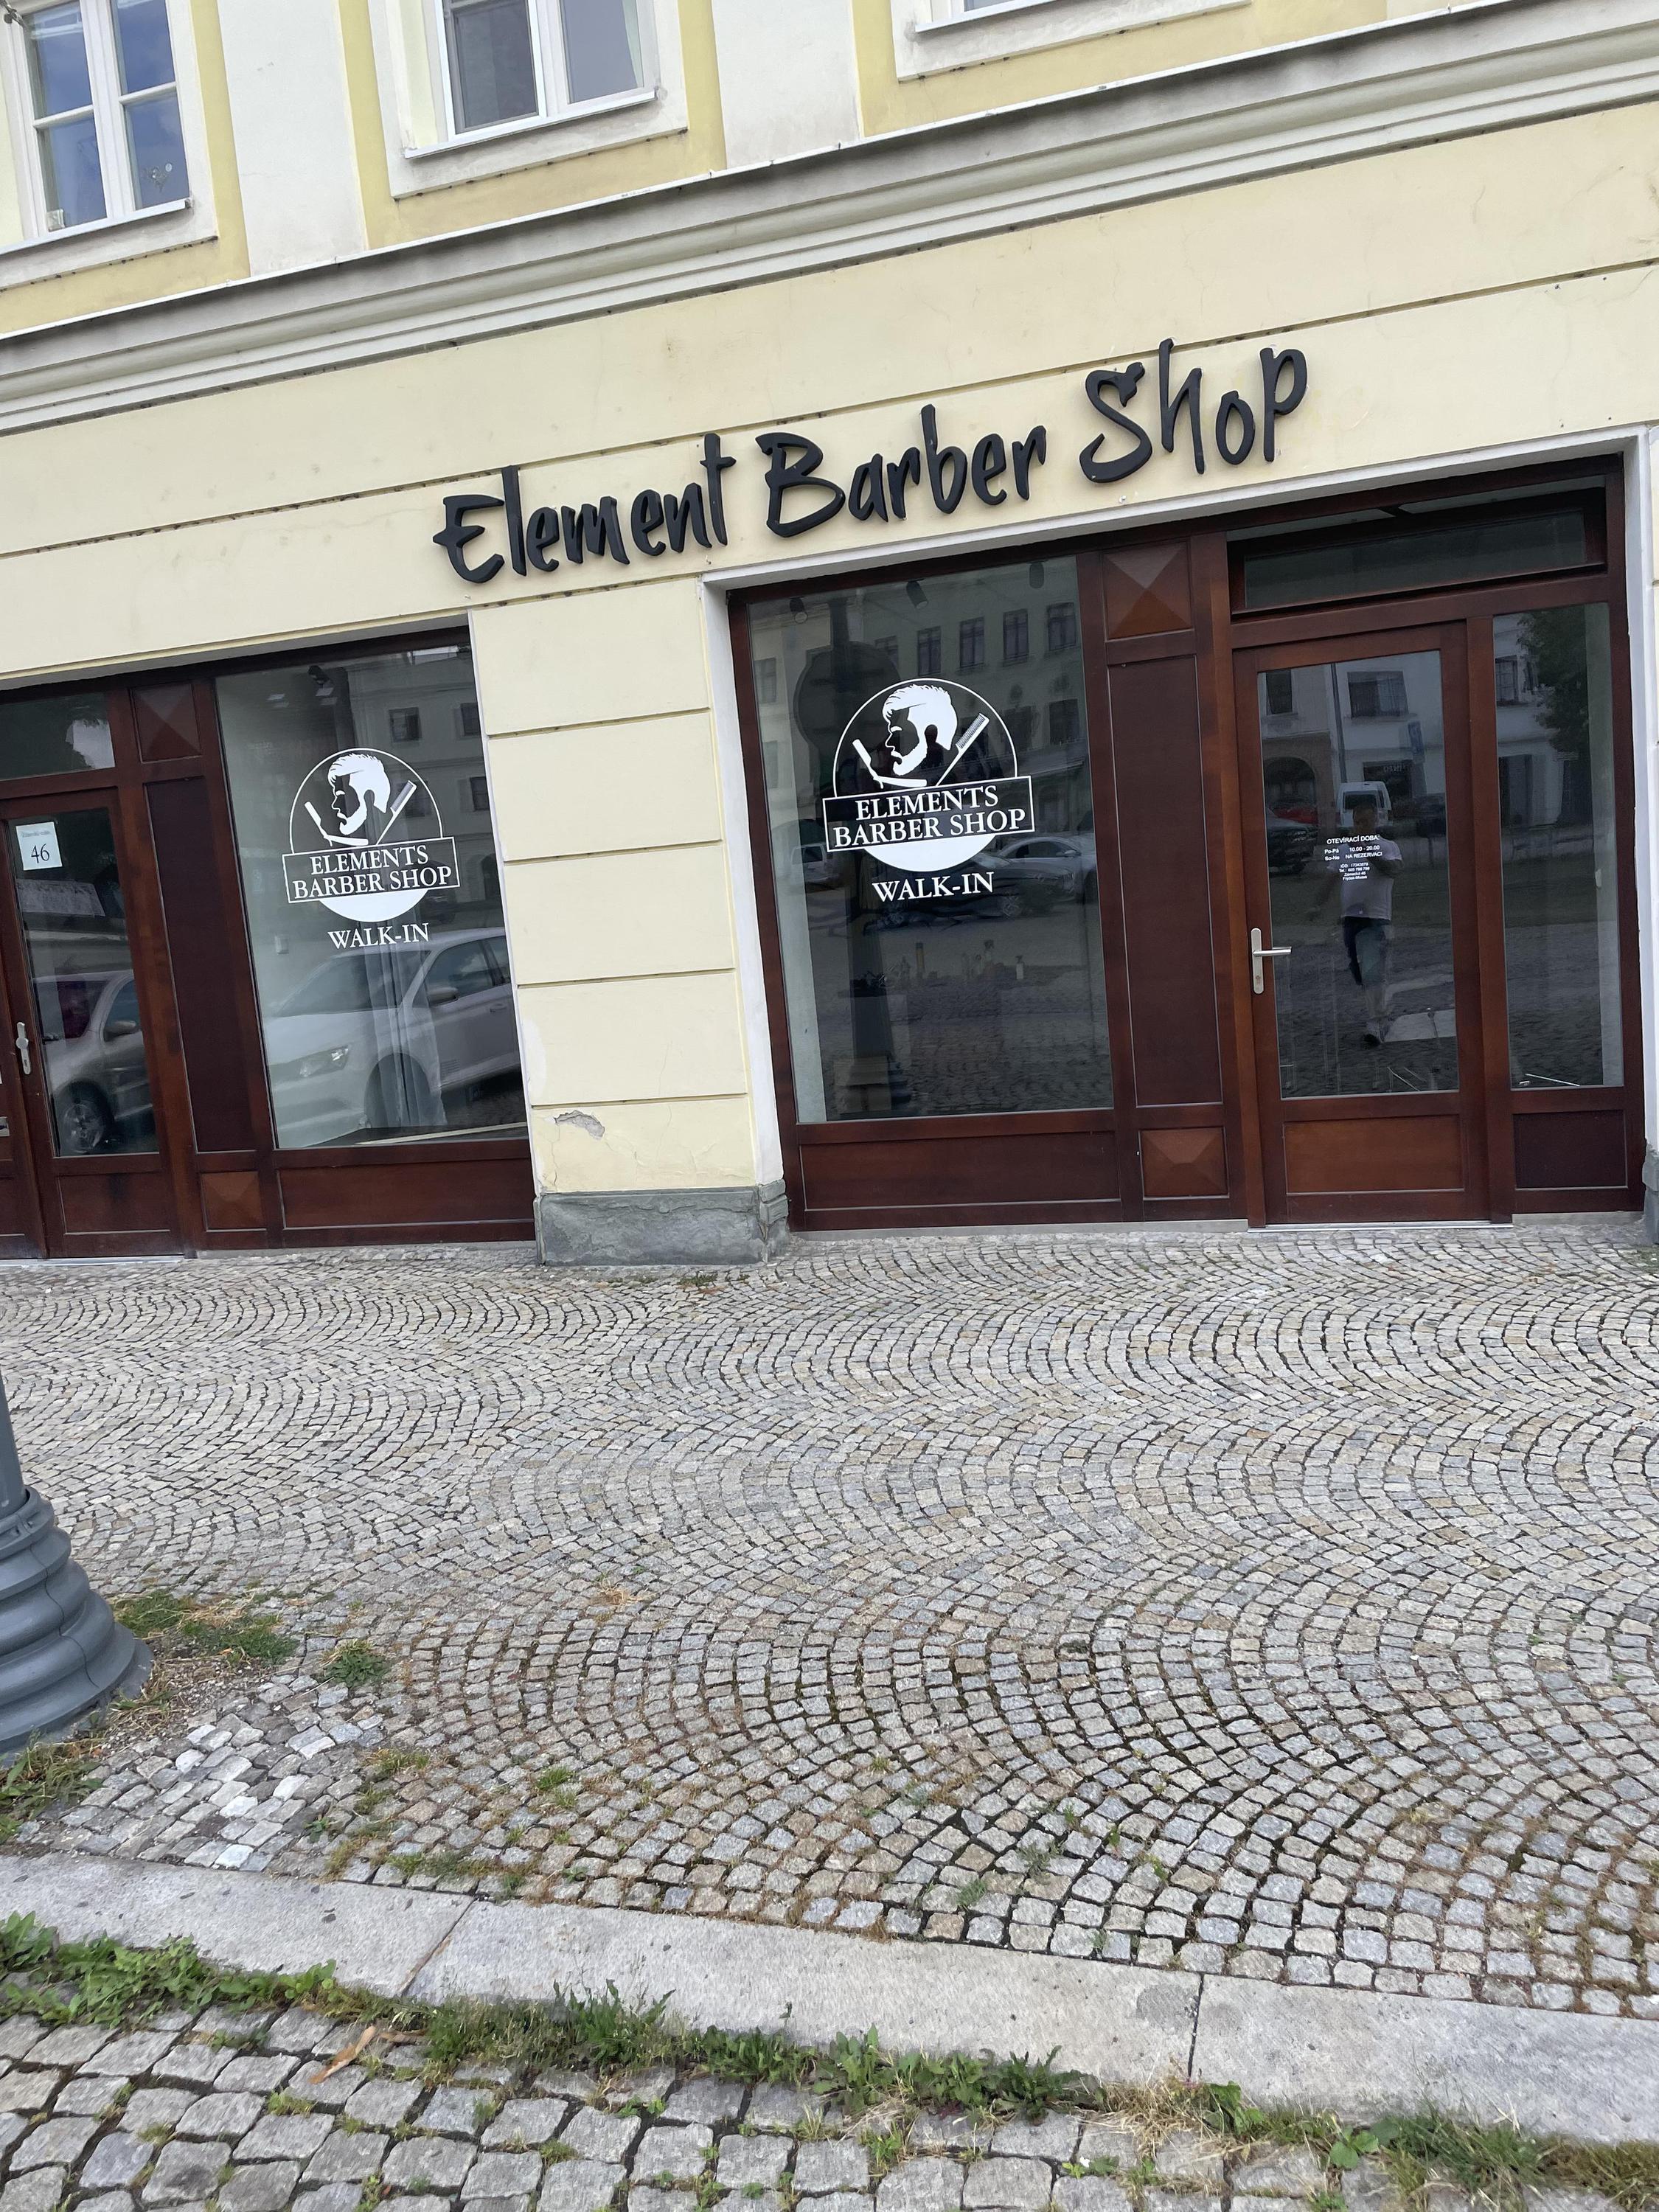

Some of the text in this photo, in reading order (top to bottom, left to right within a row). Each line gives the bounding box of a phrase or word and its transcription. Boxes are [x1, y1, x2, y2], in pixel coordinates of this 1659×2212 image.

[432, 337, 1309, 583] Element Barber Shop
[855, 785, 999, 821] ELEMENTS
[832, 808, 1026, 848] BARBER SHOP
[30, 843, 51, 864] 46
[310, 844, 429, 875] ELEMENTS
[293, 866, 452, 900] BARBER SHOP
[872, 872, 995, 902] WALK-IN
[327, 922, 429, 949] WALK-IN
